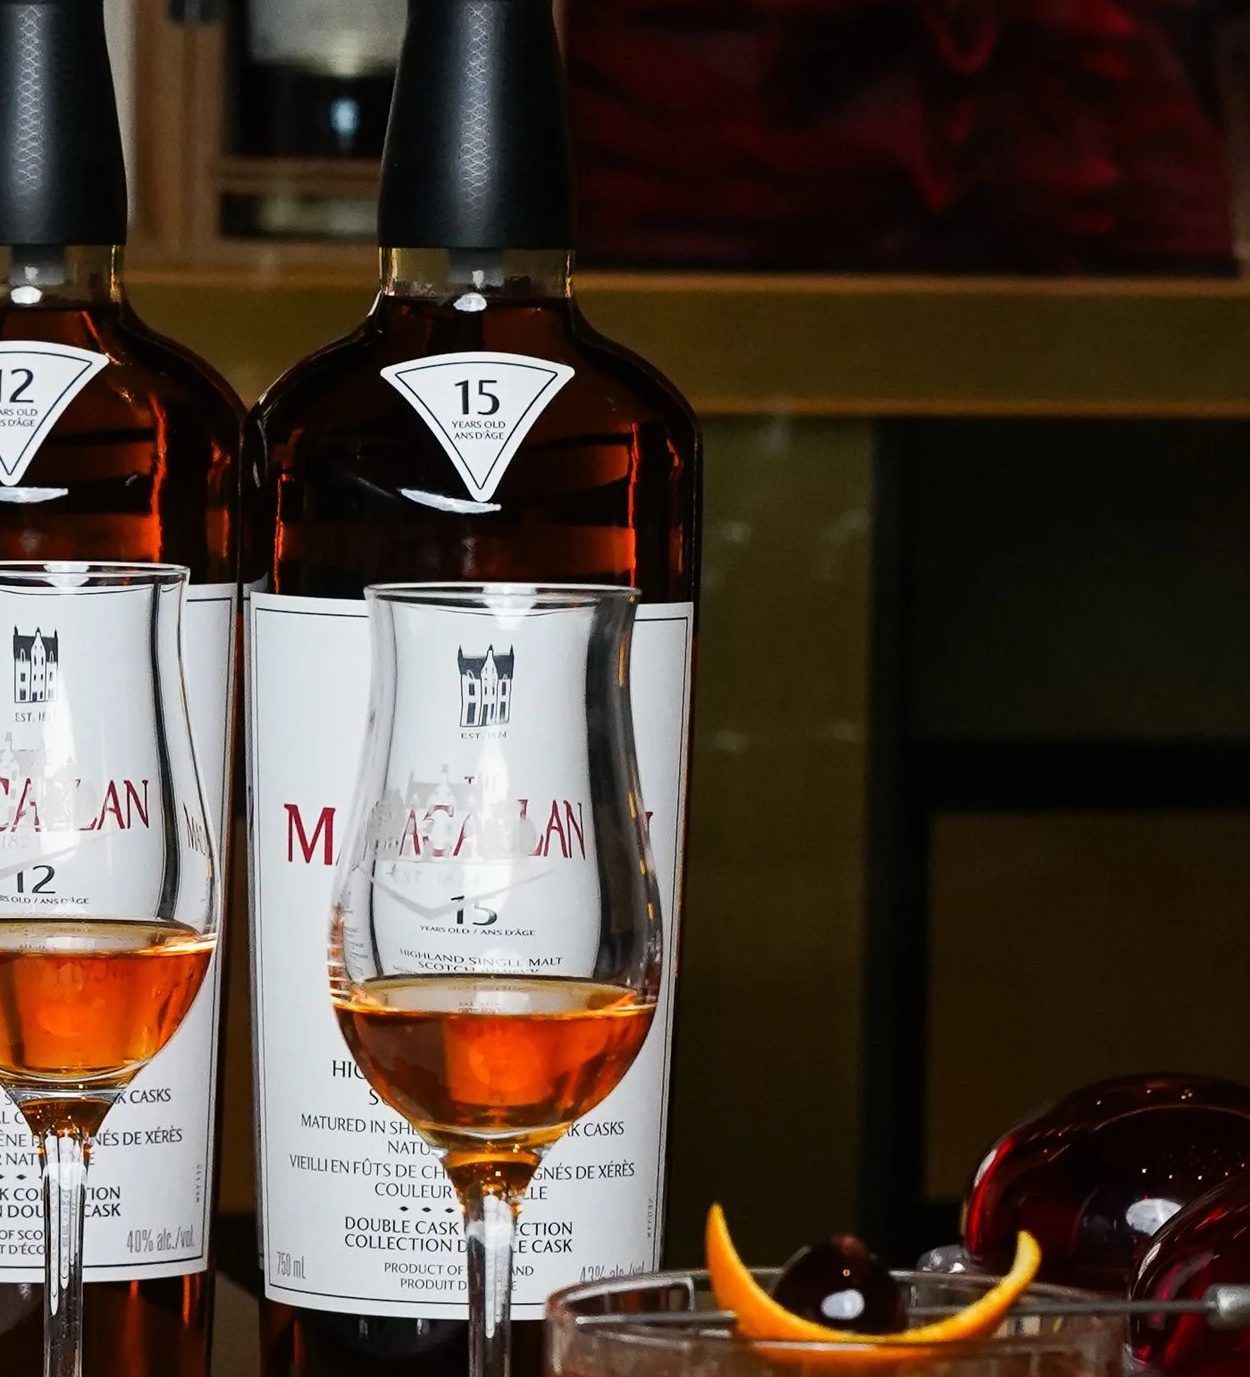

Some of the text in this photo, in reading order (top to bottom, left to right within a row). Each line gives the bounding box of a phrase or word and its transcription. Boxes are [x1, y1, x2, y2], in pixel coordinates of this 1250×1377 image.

[454, 379, 500, 416] 15
[16, 408, 38, 417] OLD
[452, 421, 506, 430] YEARS OLD
[454, 432, 474, 441] ANS
[17, 865, 56, 894] 12
[11, 895, 31, 904] OLD
[40, 896, 59, 904] ANS
[451, 895, 498, 926] 15
[420, 925, 446, 933] YEARS
[400, 948, 465, 964] HIGHLAND
[528, 957, 564, 967] MALT
[129, 1089, 172, 1103] CASKS
[301, 1114, 366, 1133] MATURED
[370, 1120, 384, 1133] IN
[584, 1121, 624, 1135] CASKS
[123, 1132, 141, 1146] DE
[146, 1127, 182, 1144] XÉRÈS
[387, 1141, 431, 1156] NATU
[290, 1154, 417, 1179] VIEILLI EN FÛTS DE
[576, 1166, 595, 1180] DE
[598, 1160, 635, 1178] XÉRÈS
[375, 1182, 452, 1199] COULEUR
[84, 1203, 121, 1217] CASK
[345, 1216, 409, 1234] DOUBLE
[415, 1221, 459, 1236] CASK
[8, 1240, 45, 1255] D'ÉCO
[126, 1228, 154, 1253] 40%
[345, 1233, 452, 1252] COLLECTION
[532, 1238, 573, 1253] CASK
[276, 1251, 292, 1276] 750
[384, 1262, 464, 1276] PRODUCT OF
[400, 1278, 455, 1291] PRODUIT
